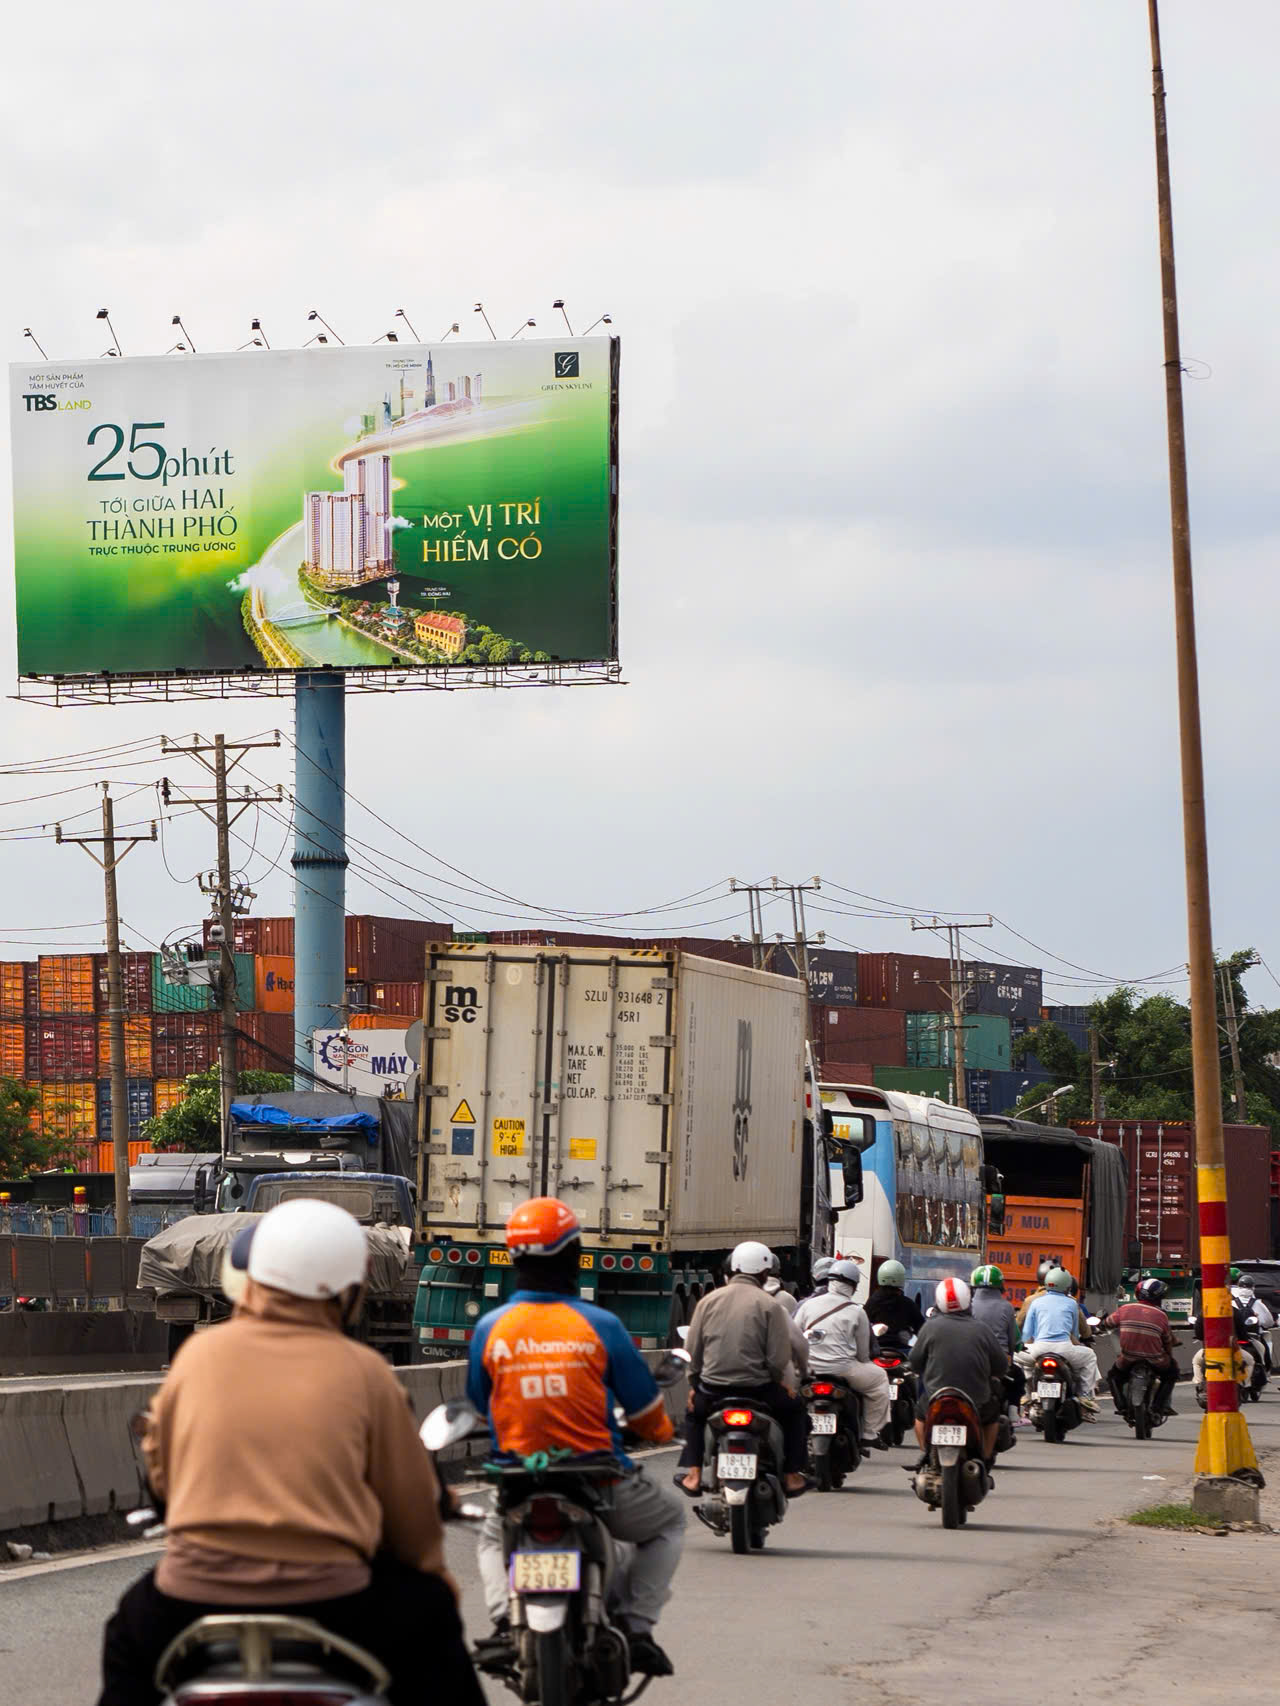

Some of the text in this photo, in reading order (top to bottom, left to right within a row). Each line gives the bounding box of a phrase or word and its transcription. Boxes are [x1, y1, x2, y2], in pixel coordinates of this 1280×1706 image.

[100, 488, 224, 514] TỚI GIỮA HAI
[423, 496, 541, 532] MỘT VỊ TRÍ
[86, 506, 238, 541] THÀNH PHỐ
[89, 542, 236, 557] TRỰC THUỘC TRUNG ƯƠNG
[423, 530, 543, 562] HIẾM CÓ
[584, 990, 664, 1005] SZLU 931648 2
[617, 1010, 640, 1022] 45R1
[332, 1045, 369, 1053] SAGON
[371, 1052, 408, 1075] MÁY
[567, 1058, 587, 1071] TARE
[567, 1072, 582, 1085] NET
[493, 1119, 525, 1131] CAUTION
[499, 1144, 518, 1155] HIGH
[491, 1252, 512, 1264] HA
[422, 1346, 450, 1358] CIMC
[515, 1337, 596, 1355] Ahamove
